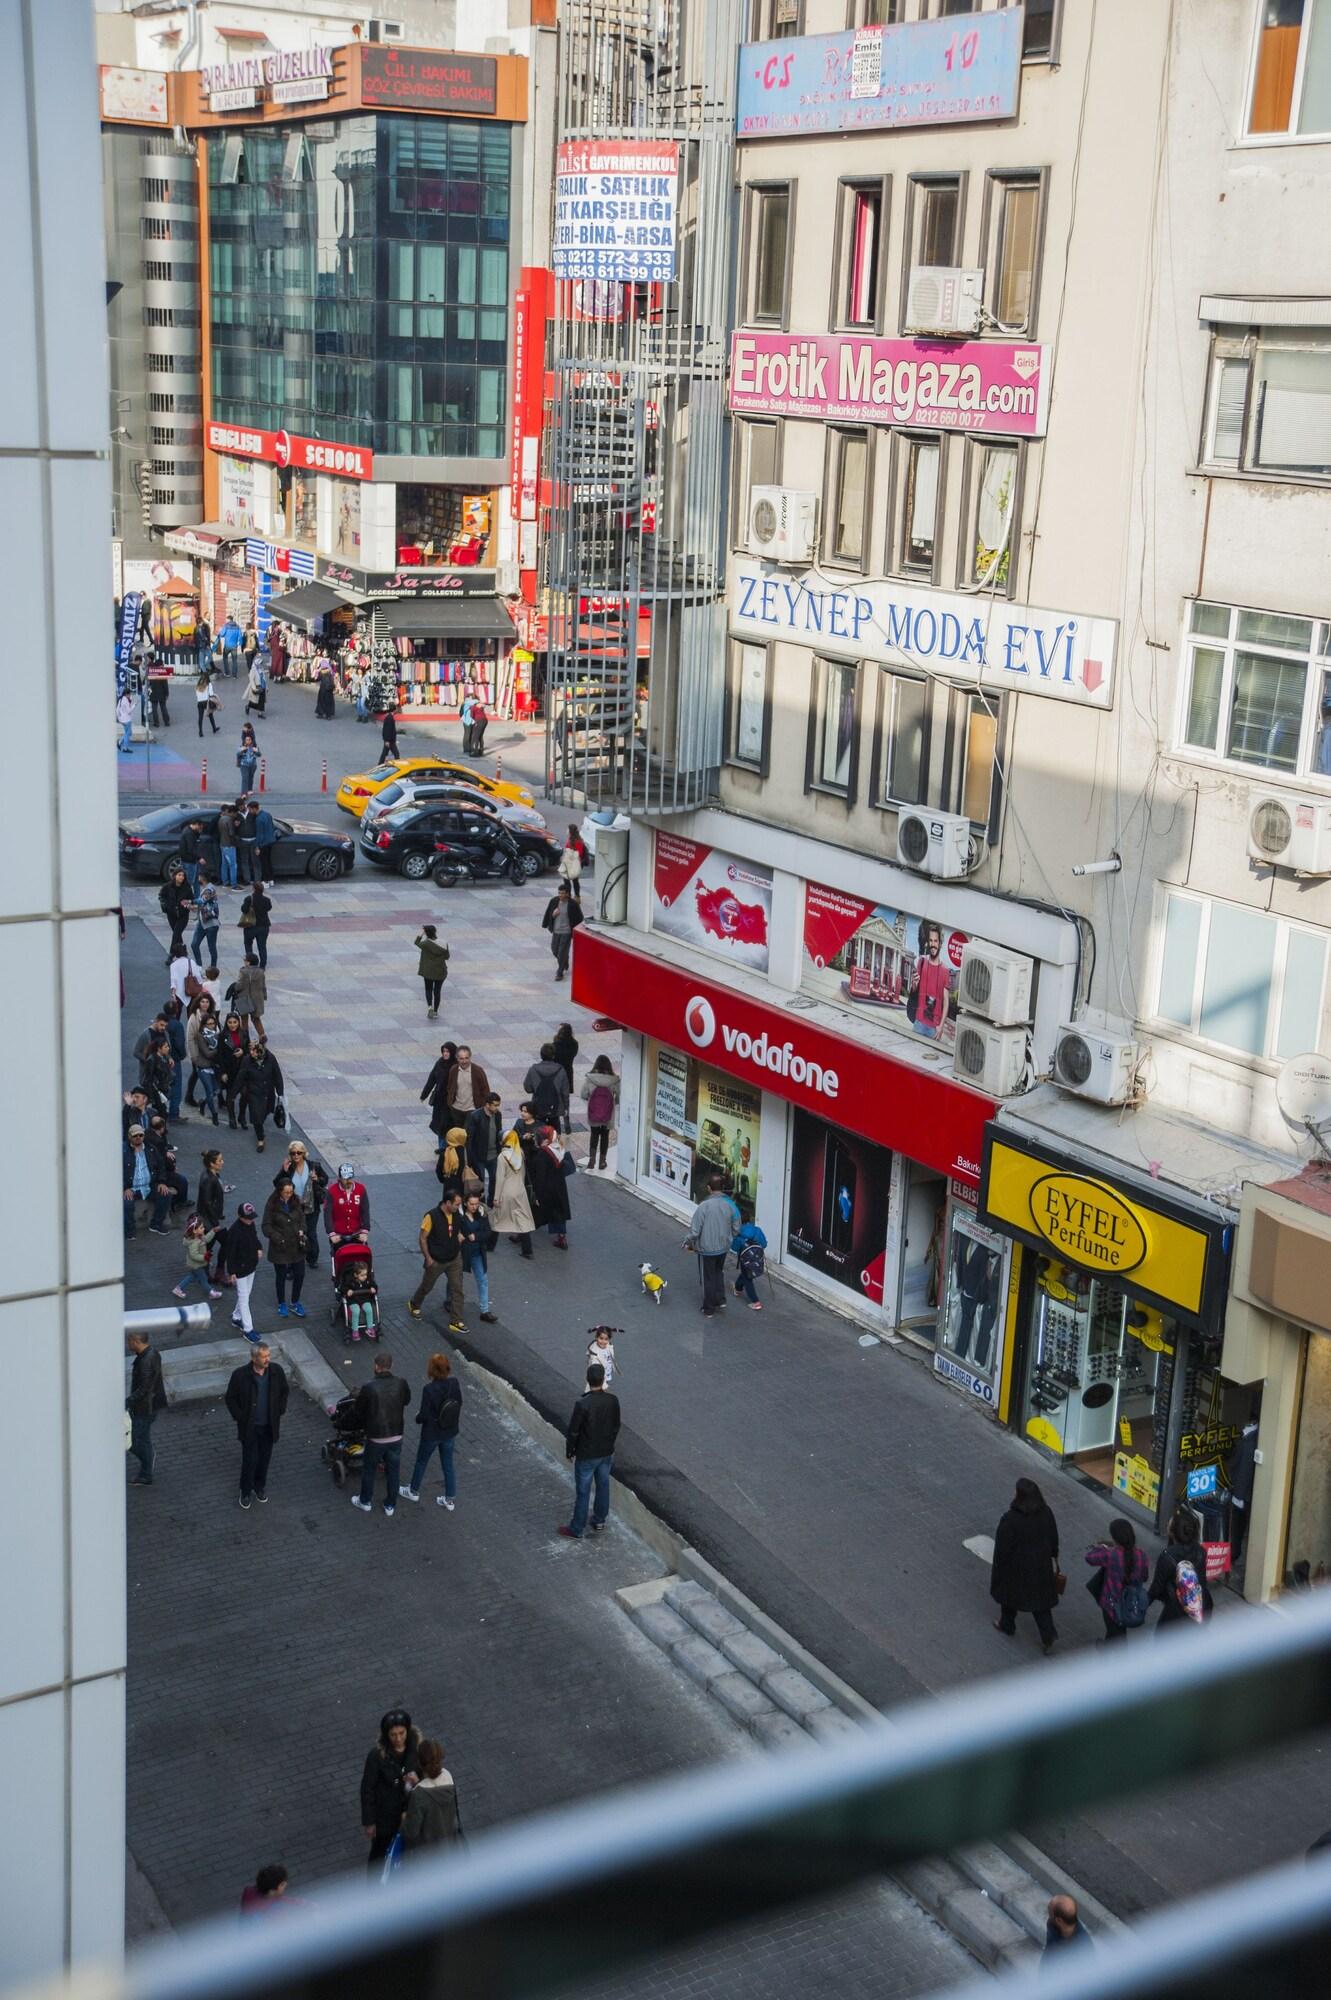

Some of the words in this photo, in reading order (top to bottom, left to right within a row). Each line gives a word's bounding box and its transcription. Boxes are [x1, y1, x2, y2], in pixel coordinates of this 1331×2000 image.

[202, 59, 260, 92] PIRLANTA
[266, 43, 330, 85] GÜZELLİK
[600, 176, 670, 197] SATILIK
[570, 198, 672, 224] KARŞILIĞI
[568, 251, 595, 264] 0212
[598, 251, 624, 264] 572
[628, 252, 639, 264] 4
[643, 252, 672, 265] 333
[568, 265, 595, 278] 0543
[599, 266, 624, 278] 611
[629, 266, 649, 279] 99
[652, 267, 672, 280] 05
[1016, 357, 1035, 370] Giriş
[733, 338, 829, 400] Erotik
[838, 342, 1035, 421] Magaza.com
[733, 395, 768, 410] Perakende
[827, 403, 861, 419] Bakırköy
[861, 406, 889, 419] Şubesi
[915, 408, 939, 423] 0212
[939, 411, 958, 425] 660
[958, 412, 972, 427] 00
[973, 413, 986, 428] 77
[209, 426, 262, 454] ENGLISH
[305, 444, 364, 475] SCHOOL
[385, 573, 464, 589] Sa-do
[738, 575, 874, 642] ZEYNEP
[886, 603, 992, 667] MODA
[1003, 620, 1078, 684] EVİ
[721, 1023, 839, 1098] vodafone
[354, 1194, 361, 1205] 5
[1045, 1186, 1126, 1246] EYFEL
[1048, 1216, 1120, 1266] Perfume
[972, 1378, 993, 1402] 60
[1181, 1424, 1240, 1450] EYFEL
[1190, 1474, 1210, 1493] 30
